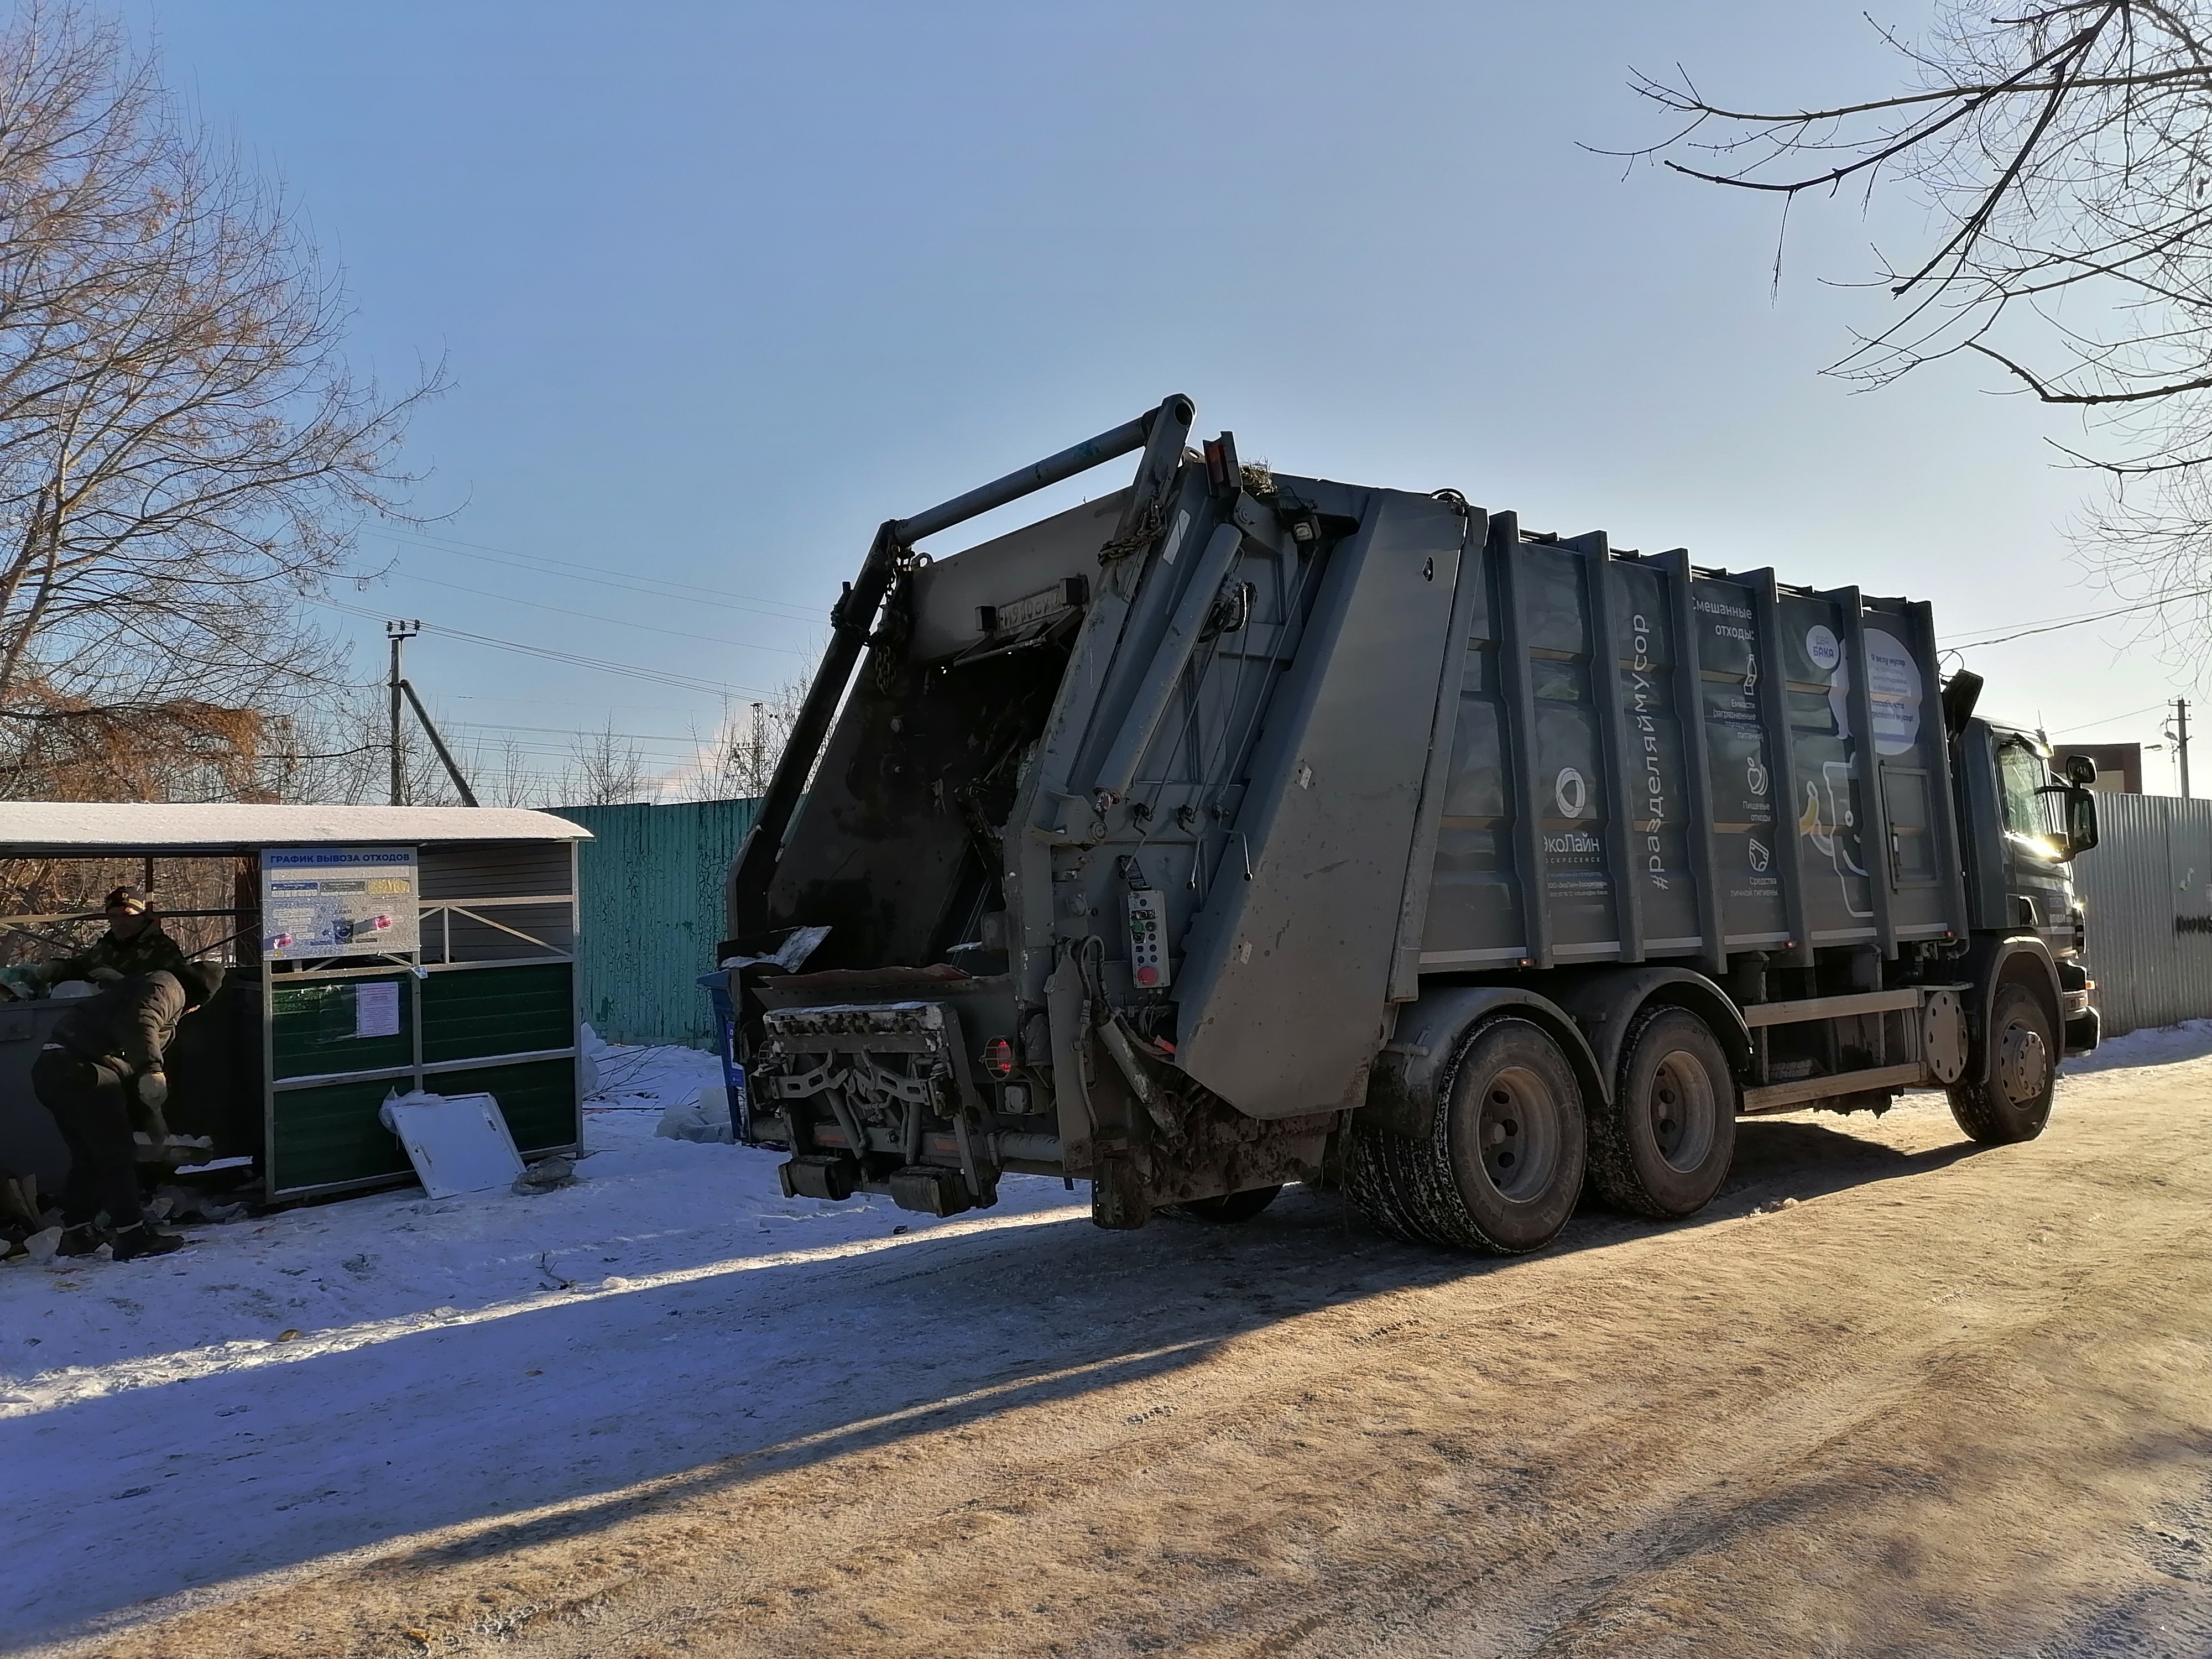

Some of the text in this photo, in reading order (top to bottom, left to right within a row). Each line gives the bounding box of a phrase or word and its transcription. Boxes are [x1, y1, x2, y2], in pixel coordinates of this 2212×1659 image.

[1715, 624, 1755, 641] отходы:
[1813, 646, 1834, 659] БАКА
[1632, 613, 1669, 891] #разделяймусор
[270, 853, 410, 863] ГРАФИК ВЫВОЗА ОТХОДОВ
